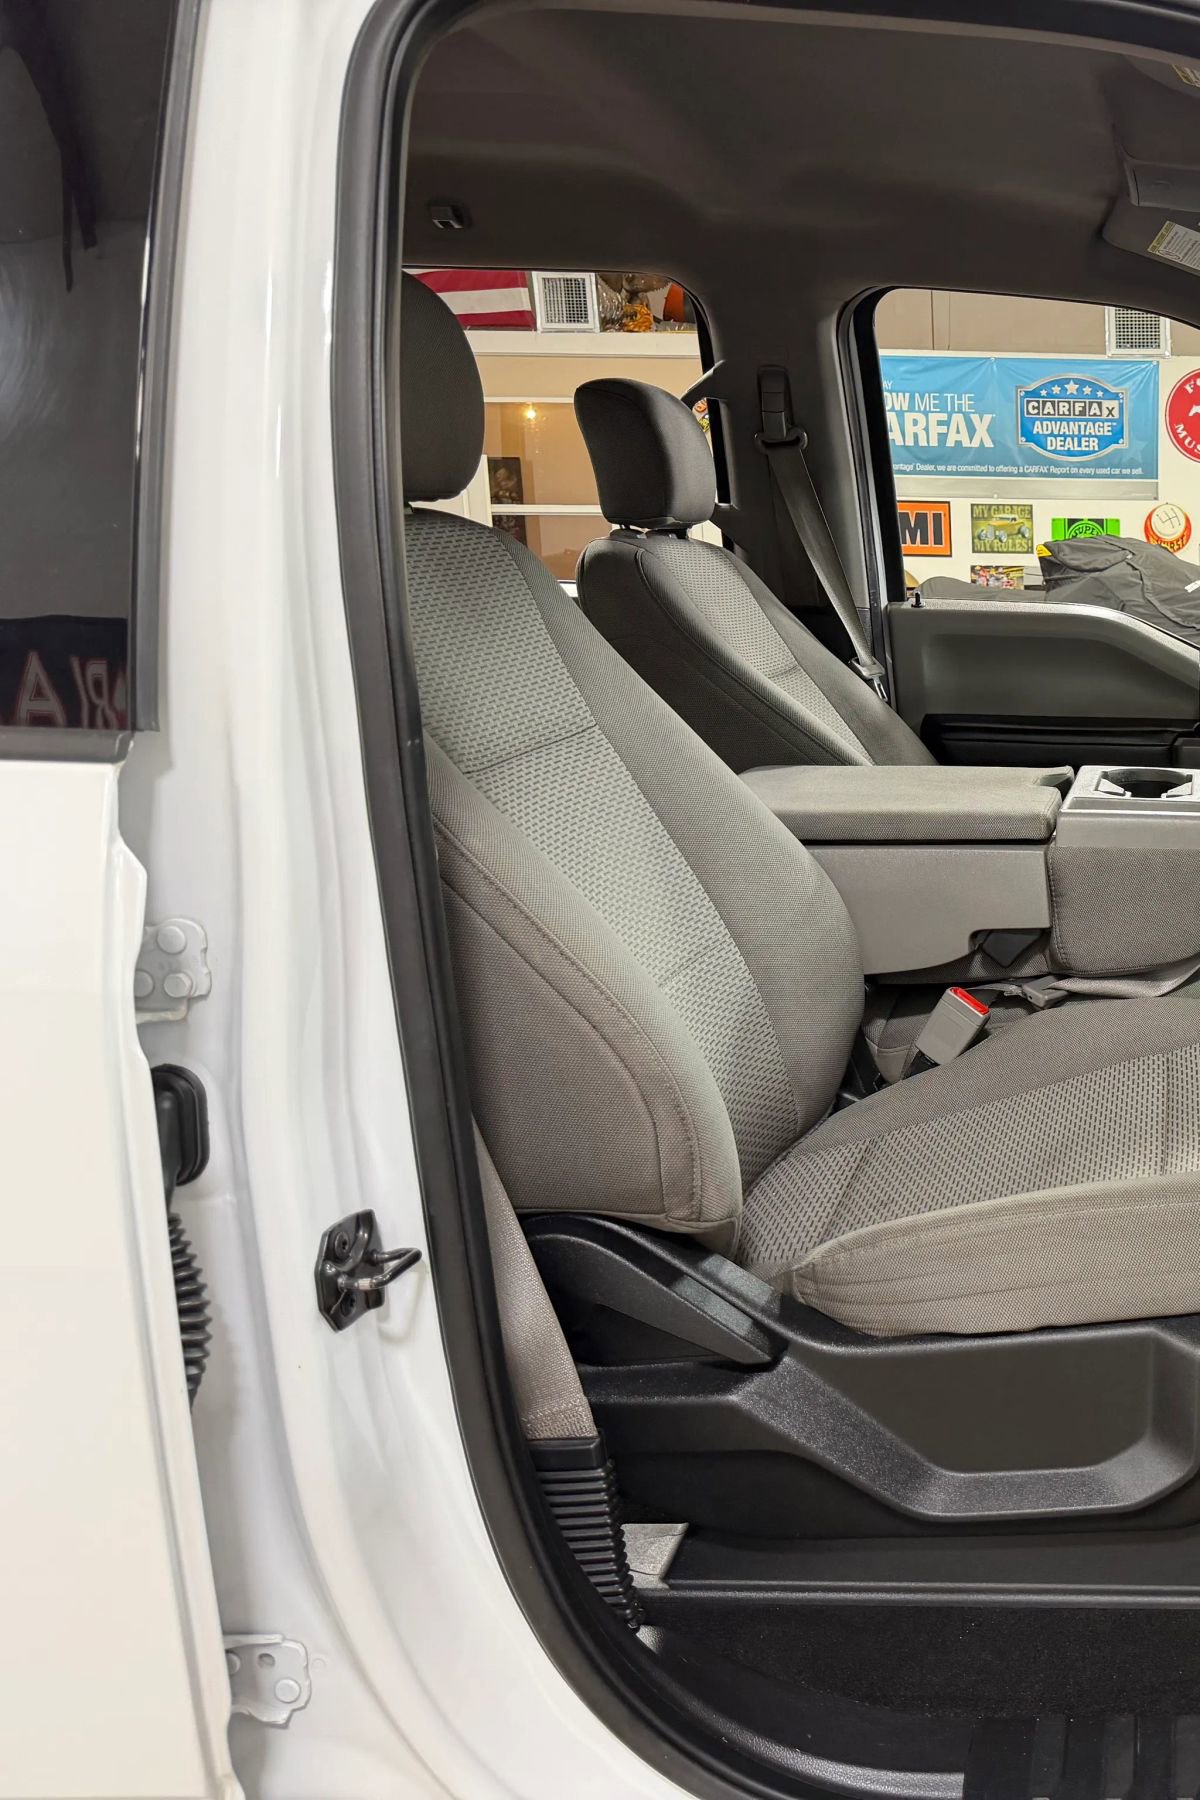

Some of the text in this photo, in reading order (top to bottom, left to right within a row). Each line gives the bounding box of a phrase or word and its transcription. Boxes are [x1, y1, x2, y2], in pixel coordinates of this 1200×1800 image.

[883, 392, 976, 412] OW ME THE
[1027, 401, 1115, 418] CARFAX
[886, 412, 995, 448] ARFAX
[1033, 421, 1113, 436] ADVANTAGE
[1047, 437, 1099, 451] DEALER
[973, 505, 1031, 518] MY GARAGE
[897, 511, 944, 546] MI
[974, 539, 991, 552] MY
[994, 539, 1032, 552] RULES!
